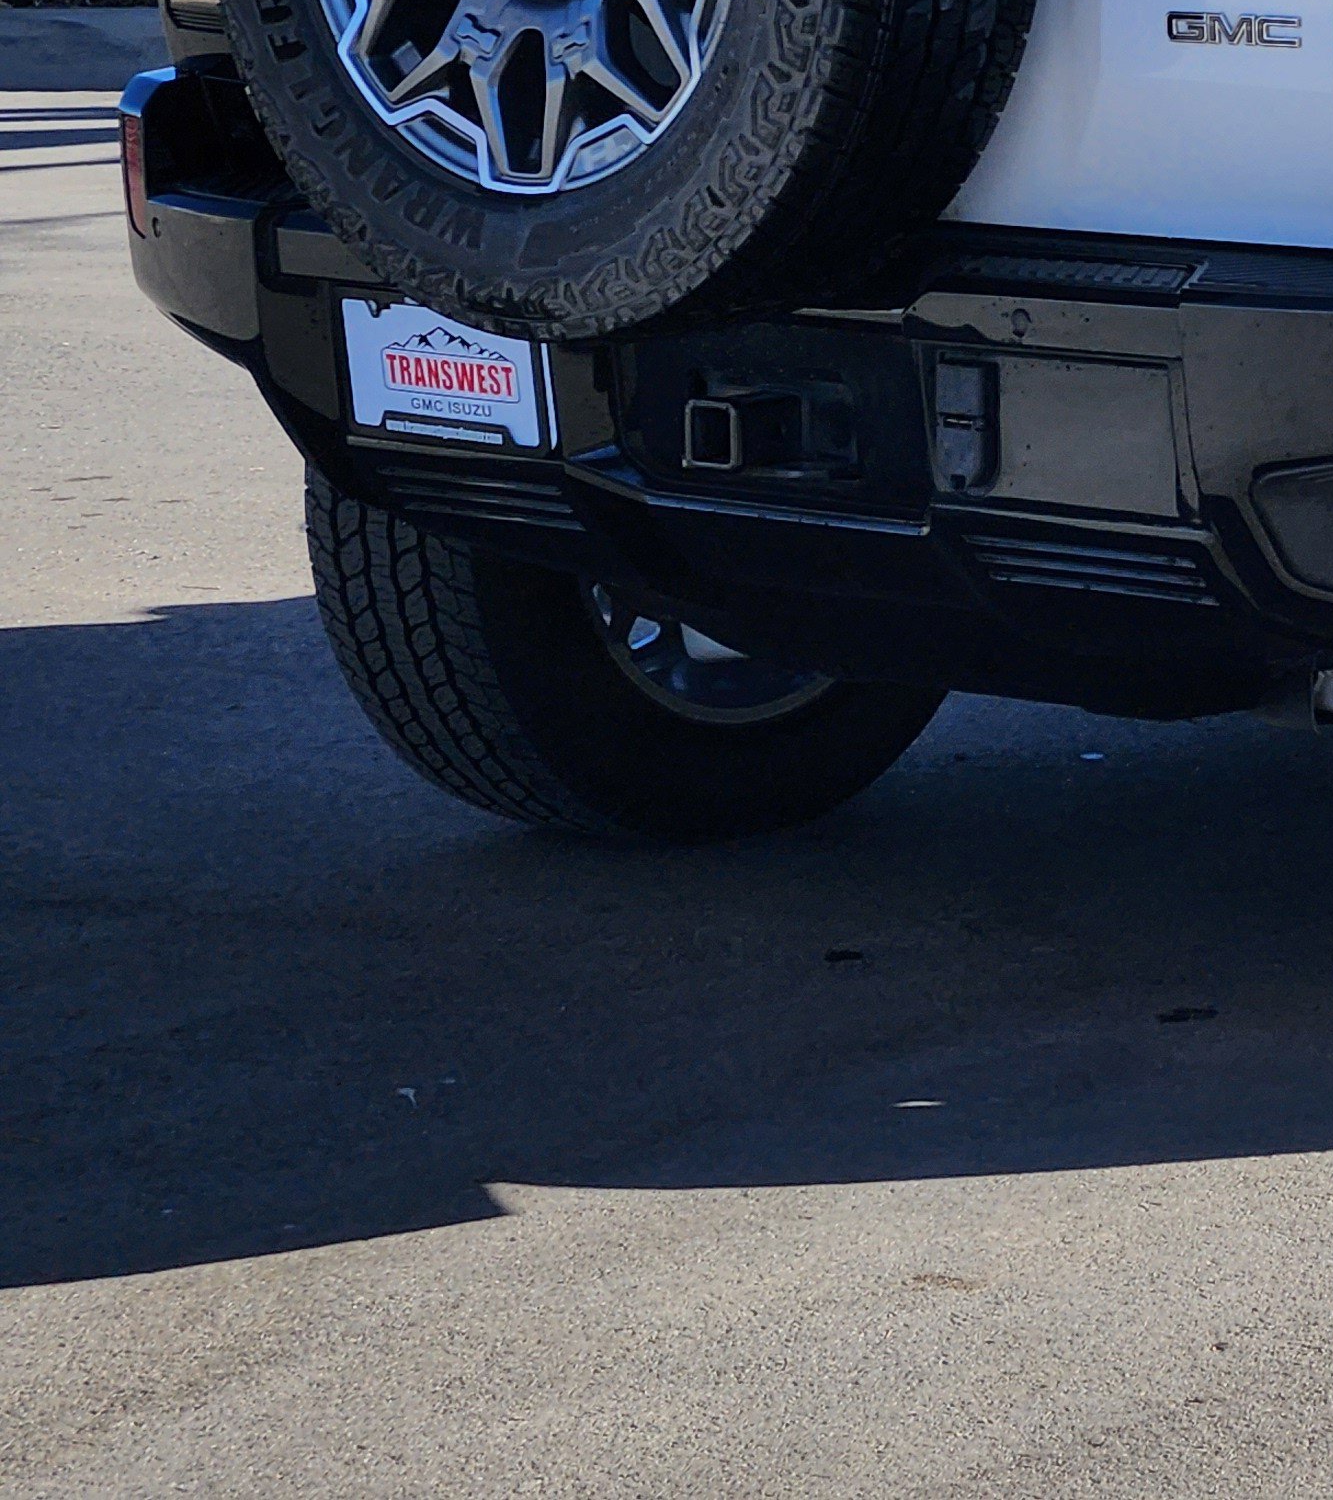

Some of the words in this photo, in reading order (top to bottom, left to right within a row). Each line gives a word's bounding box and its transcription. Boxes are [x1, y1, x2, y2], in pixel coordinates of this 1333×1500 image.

[1166, 10, 1302, 49] GMC
[385, 353, 514, 397] TRANSWEST
[410, 396, 444, 413] GMC
[448, 399, 493, 418] ISUZU
